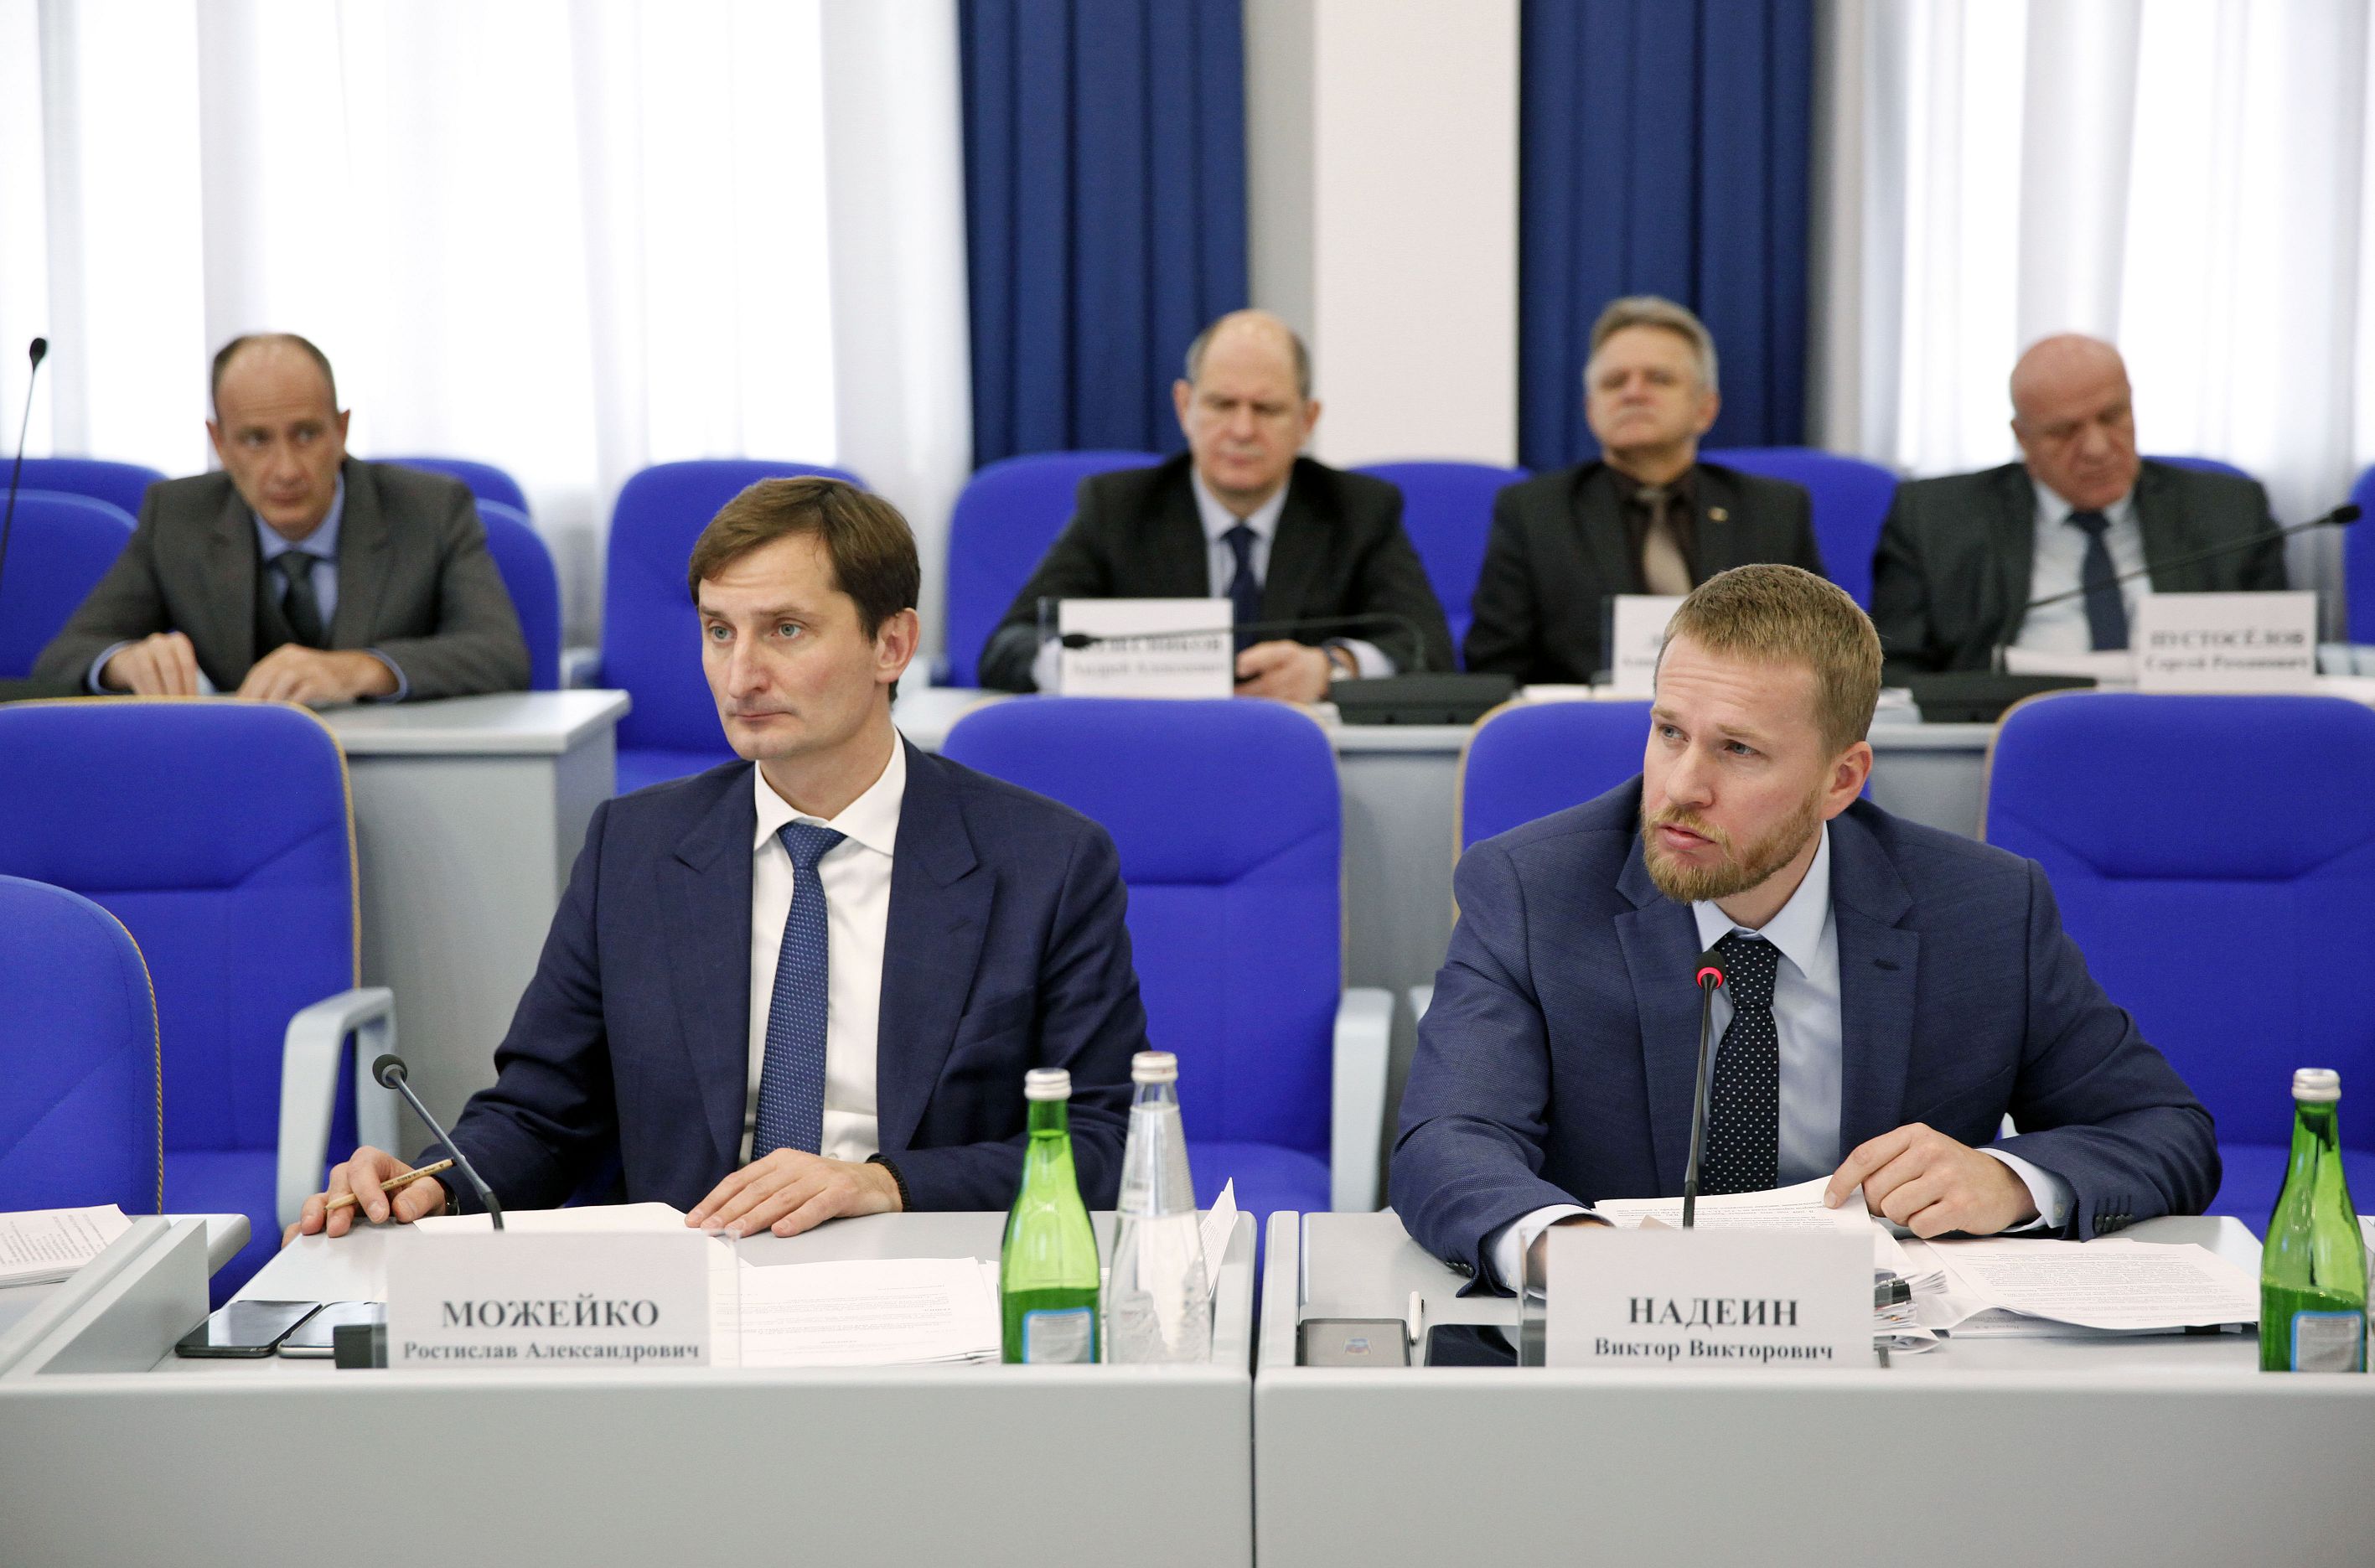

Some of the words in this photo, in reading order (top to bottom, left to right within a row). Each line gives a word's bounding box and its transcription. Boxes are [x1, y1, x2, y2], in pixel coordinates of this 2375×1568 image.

[442, 1293, 659, 1327] МОЖЕЙКО
[1629, 1296, 1798, 1330] НАДЕИН
[404, 1343, 518, 1359] Ростислав
[525, 1343, 699, 1363] Александрович
[1595, 1338, 1680, 1361] Виктор
[1690, 1339, 1833, 1364] Викторович
